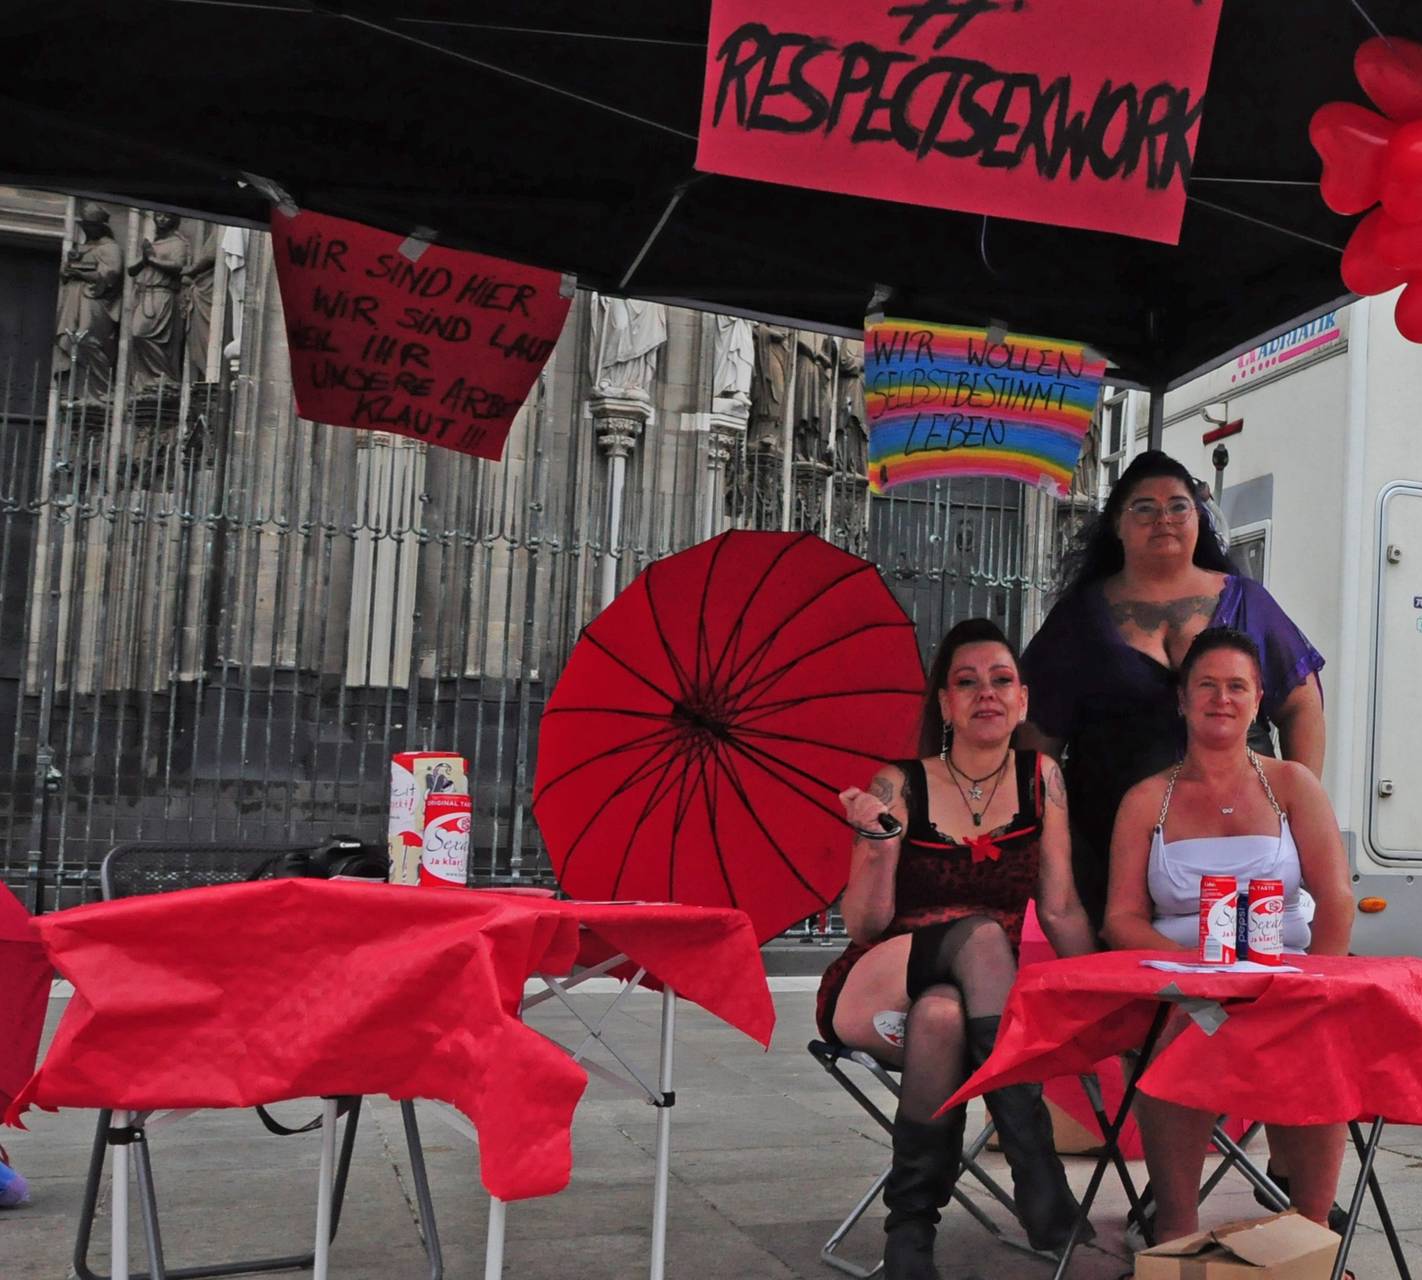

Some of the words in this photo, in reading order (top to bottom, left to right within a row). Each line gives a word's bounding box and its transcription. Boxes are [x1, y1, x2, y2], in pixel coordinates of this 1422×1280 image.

[287, 232, 348, 273] WIR
[366, 254, 452, 298] SIND
[456, 274, 536, 317] HIER
[312, 286, 380, 326] WIR
[396, 308, 471, 342] SIND
[872, 330, 935, 366] WIR
[967, 338, 1085, 379] WOLLEN
[310, 361, 435, 396] UNSERE
[872, 367, 1081, 419] SELBSTBESTIMMT
[351, 395, 454, 439] KLAUT
[904, 412, 1006, 456] LEBEN
[1238, 907, 1247, 943] pepsi
